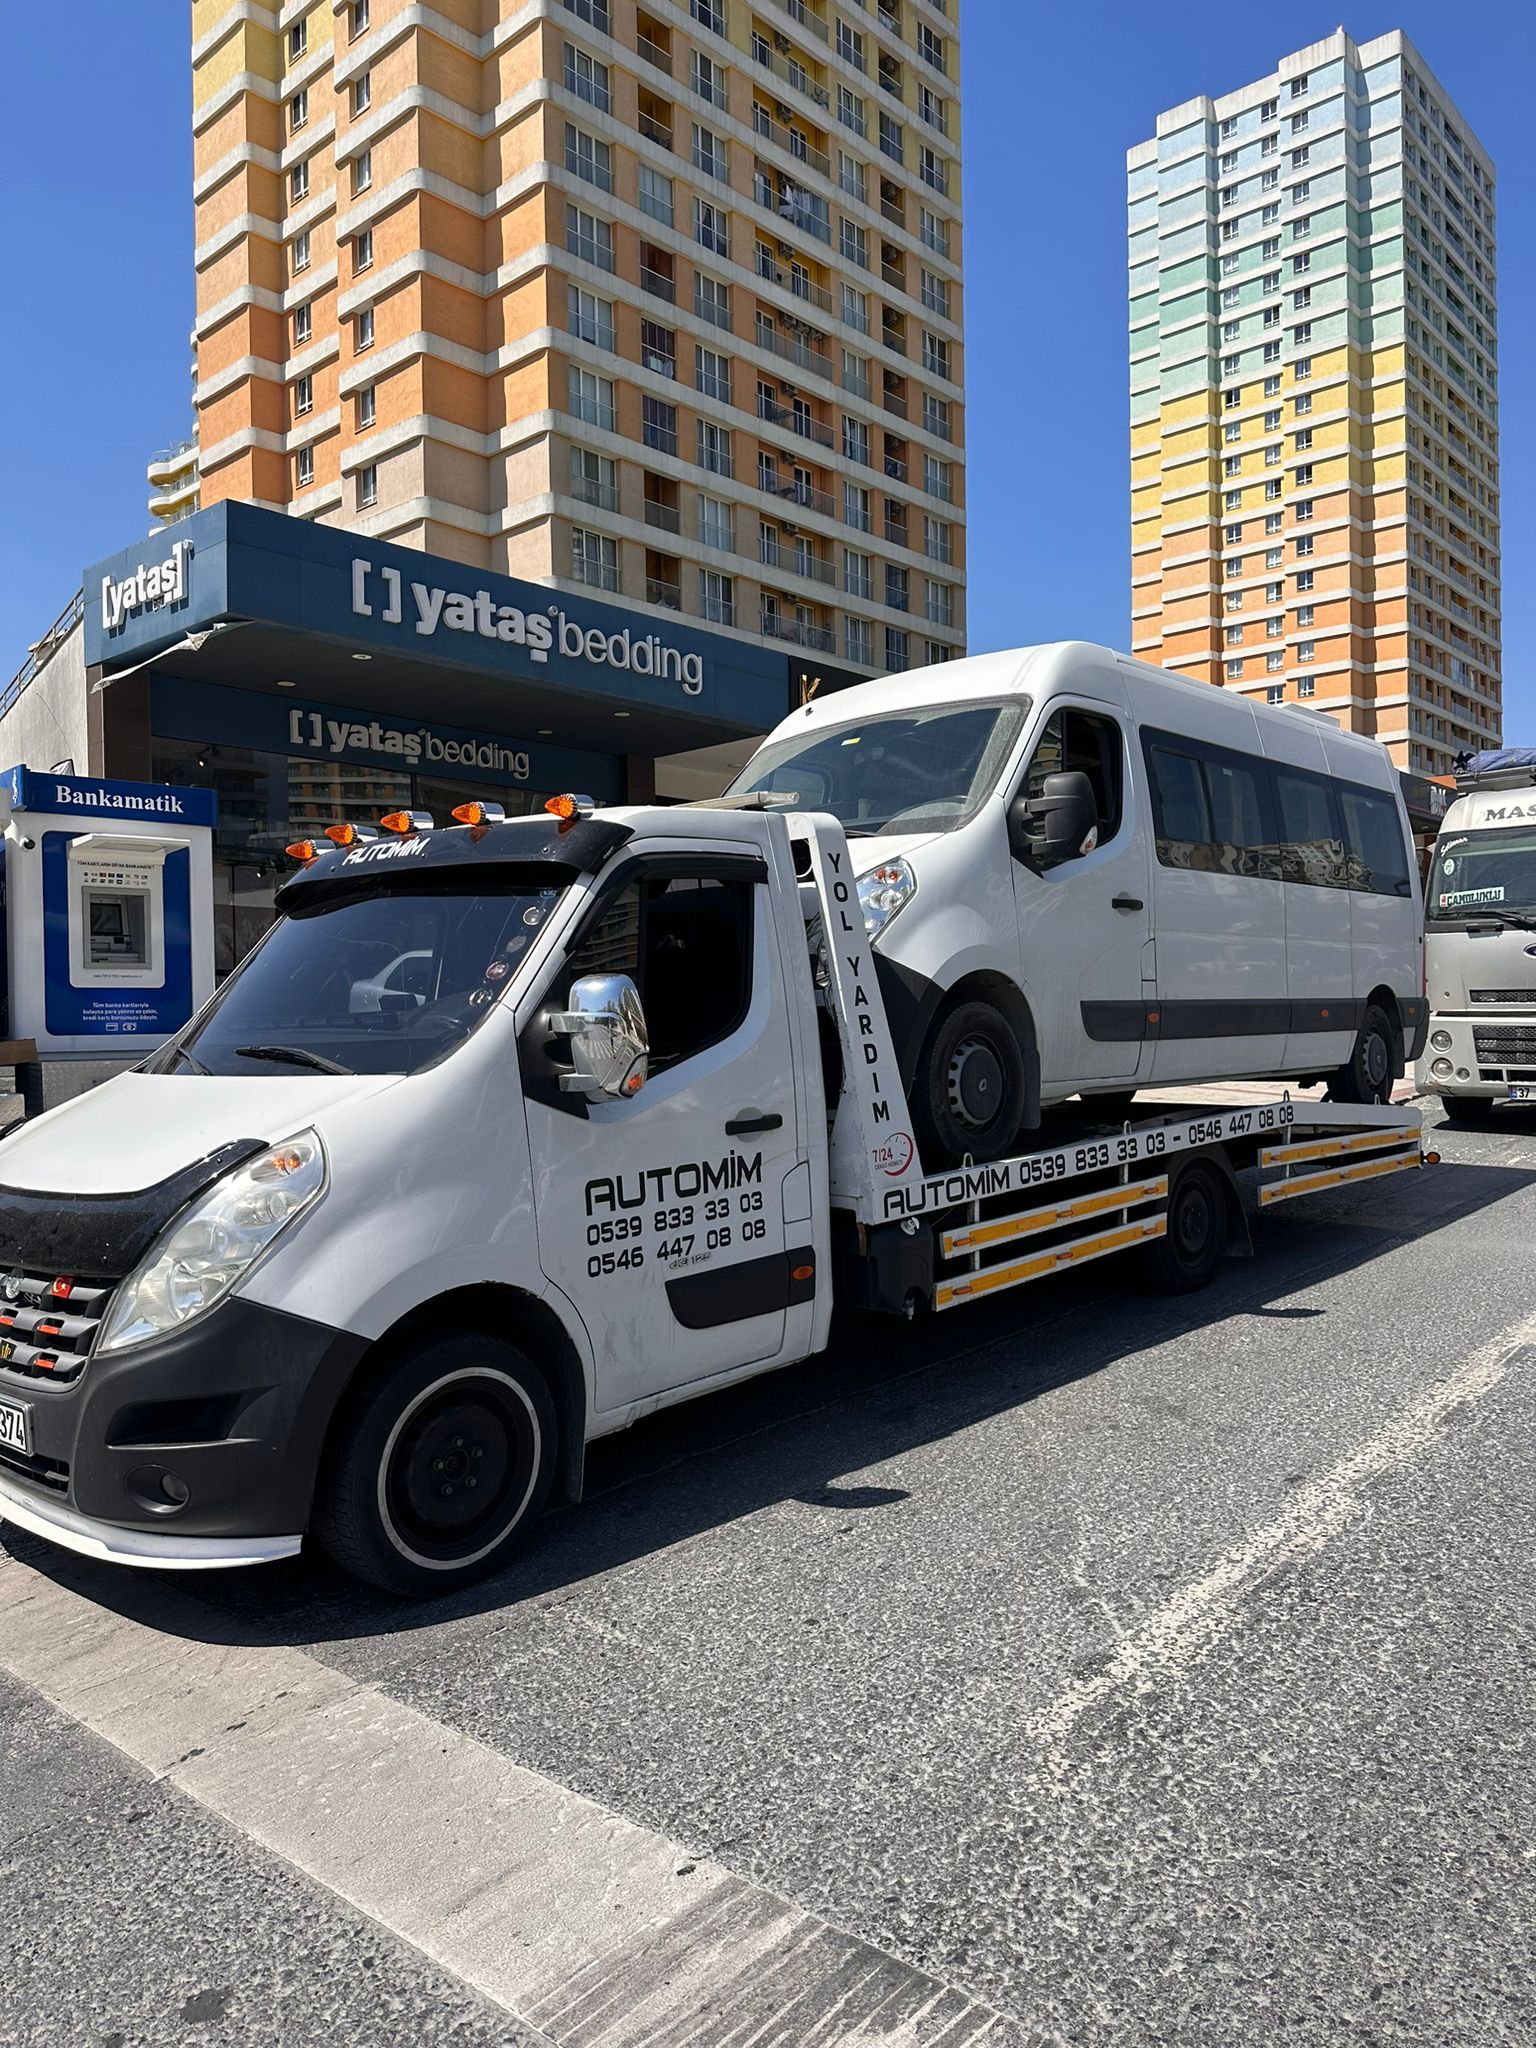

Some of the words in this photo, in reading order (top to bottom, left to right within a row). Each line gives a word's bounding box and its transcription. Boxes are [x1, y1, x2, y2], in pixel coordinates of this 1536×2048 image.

[411, 582, 554, 663] yataş
[558, 611, 704, 696] bedding
[327, 721, 422, 764] yataş
[425, 731, 530, 780] bedding
[56, 785, 185, 814] Bankamatik
[828, 853, 853, 931] YOL
[847, 956, 890, 1123] YARDIM
[1518, 1088, 1530, 1099] 37
[585, 1150, 762, 1216] AUTOMİM
[884, 1165, 1010, 1218] AUTOMİM
[1020, 1154, 1066, 1184] 0539
[1076, 1143, 1109, 1172] 833
[1117, 1137, 1137, 1161] 33
[1146, 1132, 1165, 1154] 03
[1188, 1120, 1222, 1144] 0546
[1229, 1113, 1252, 1134] 447
[1258, 1108, 1274, 1128] 08
[1279, 1106, 1294, 1124] 08
[587, 1216, 642, 1246] 0539
[654, 1205, 694, 1232] 833
[705, 1198, 730, 1221] 33
[740, 1191, 763, 1213] 03
[587, 1246, 644, 1278] 0546
[657, 1234, 695, 1261] 447
[707, 1227, 731, 1249] 08
[742, 1219, 765, 1241] 08
[0, 1407, 24, 1446] 374
